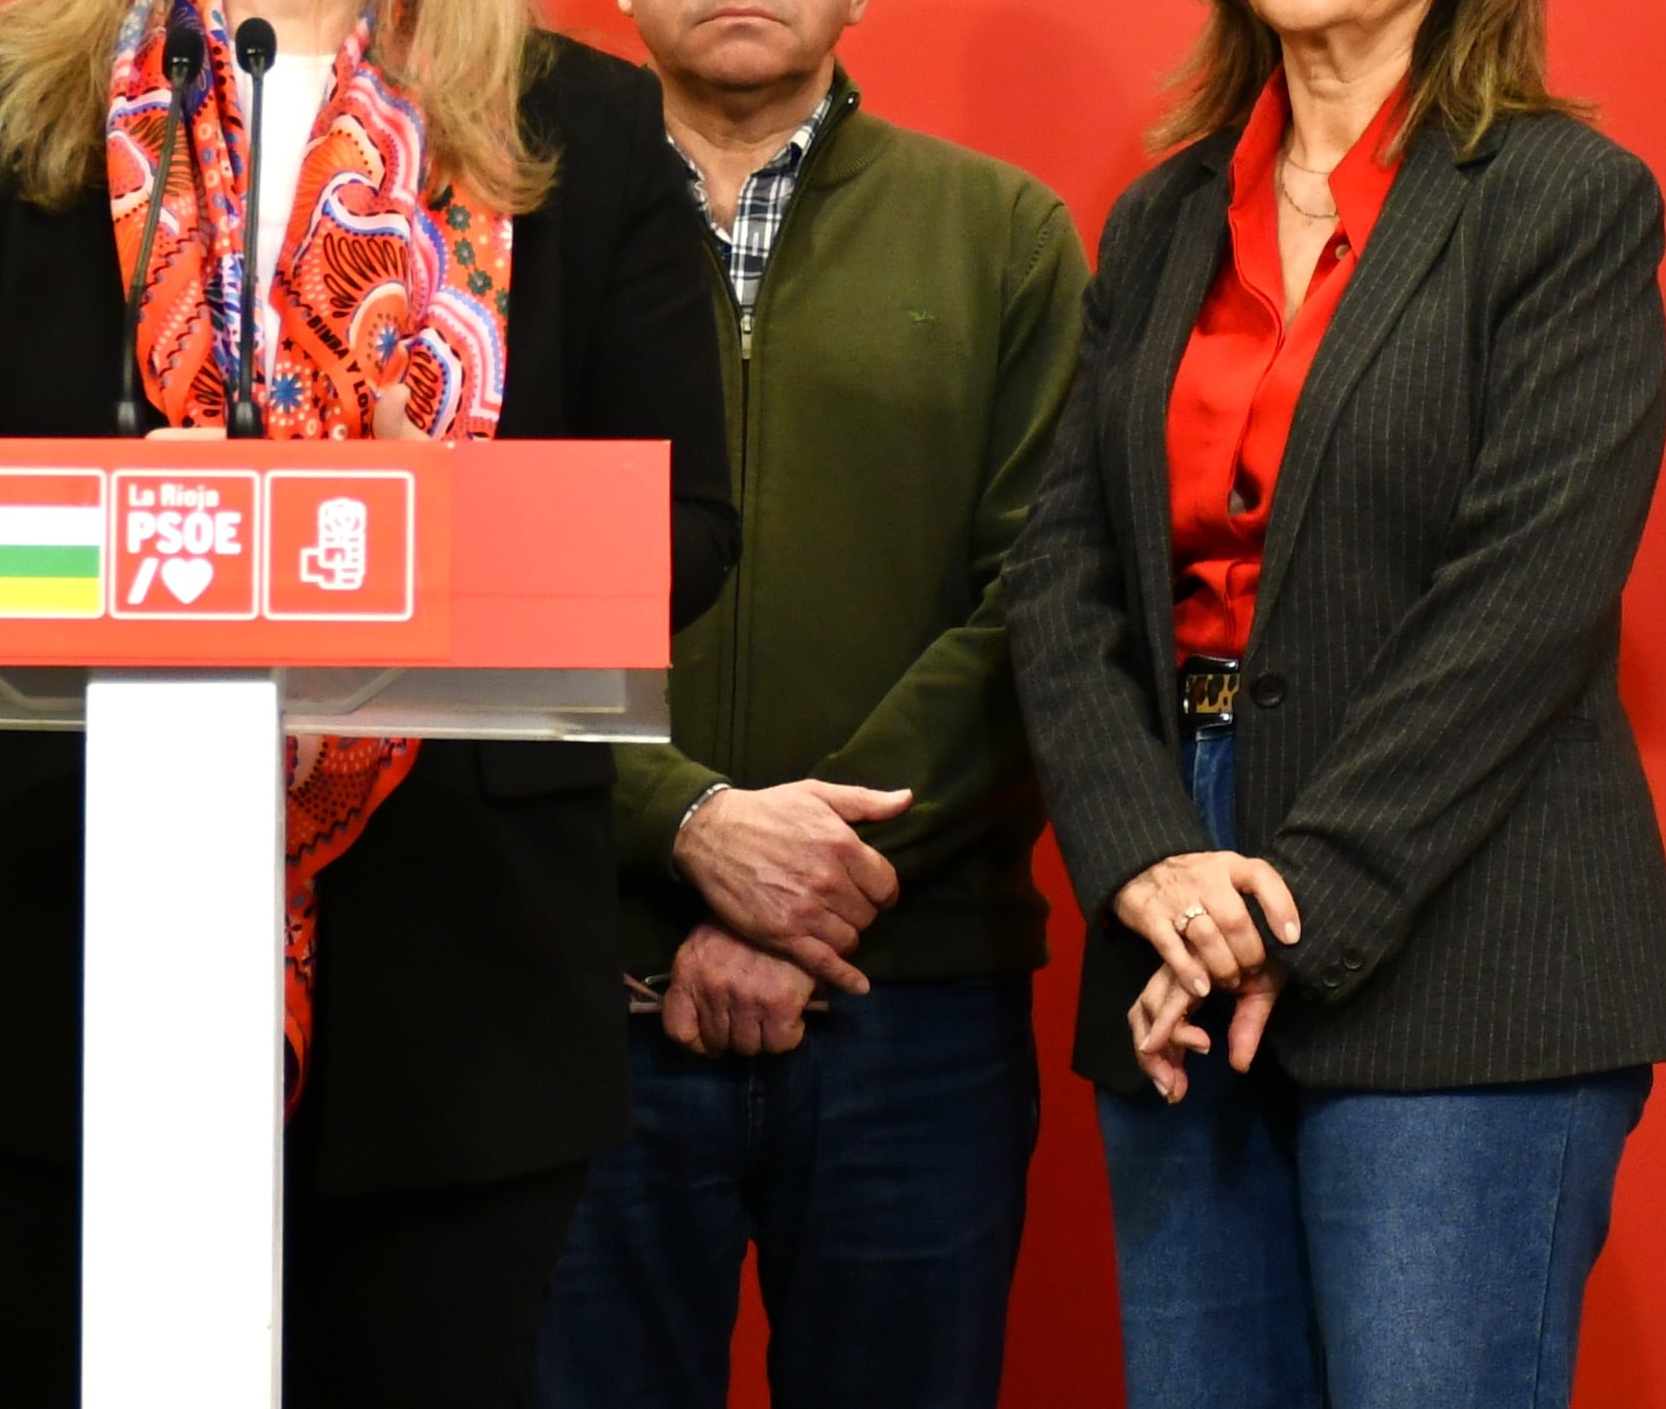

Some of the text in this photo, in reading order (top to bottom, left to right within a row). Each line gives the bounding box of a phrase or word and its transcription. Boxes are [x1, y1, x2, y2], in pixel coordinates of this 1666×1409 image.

[307, 315, 350, 360] BIMBA
[346, 360, 361, 373] Y
[128, 483, 219, 513] La Rioja
[127, 511, 242, 554] PSOE
